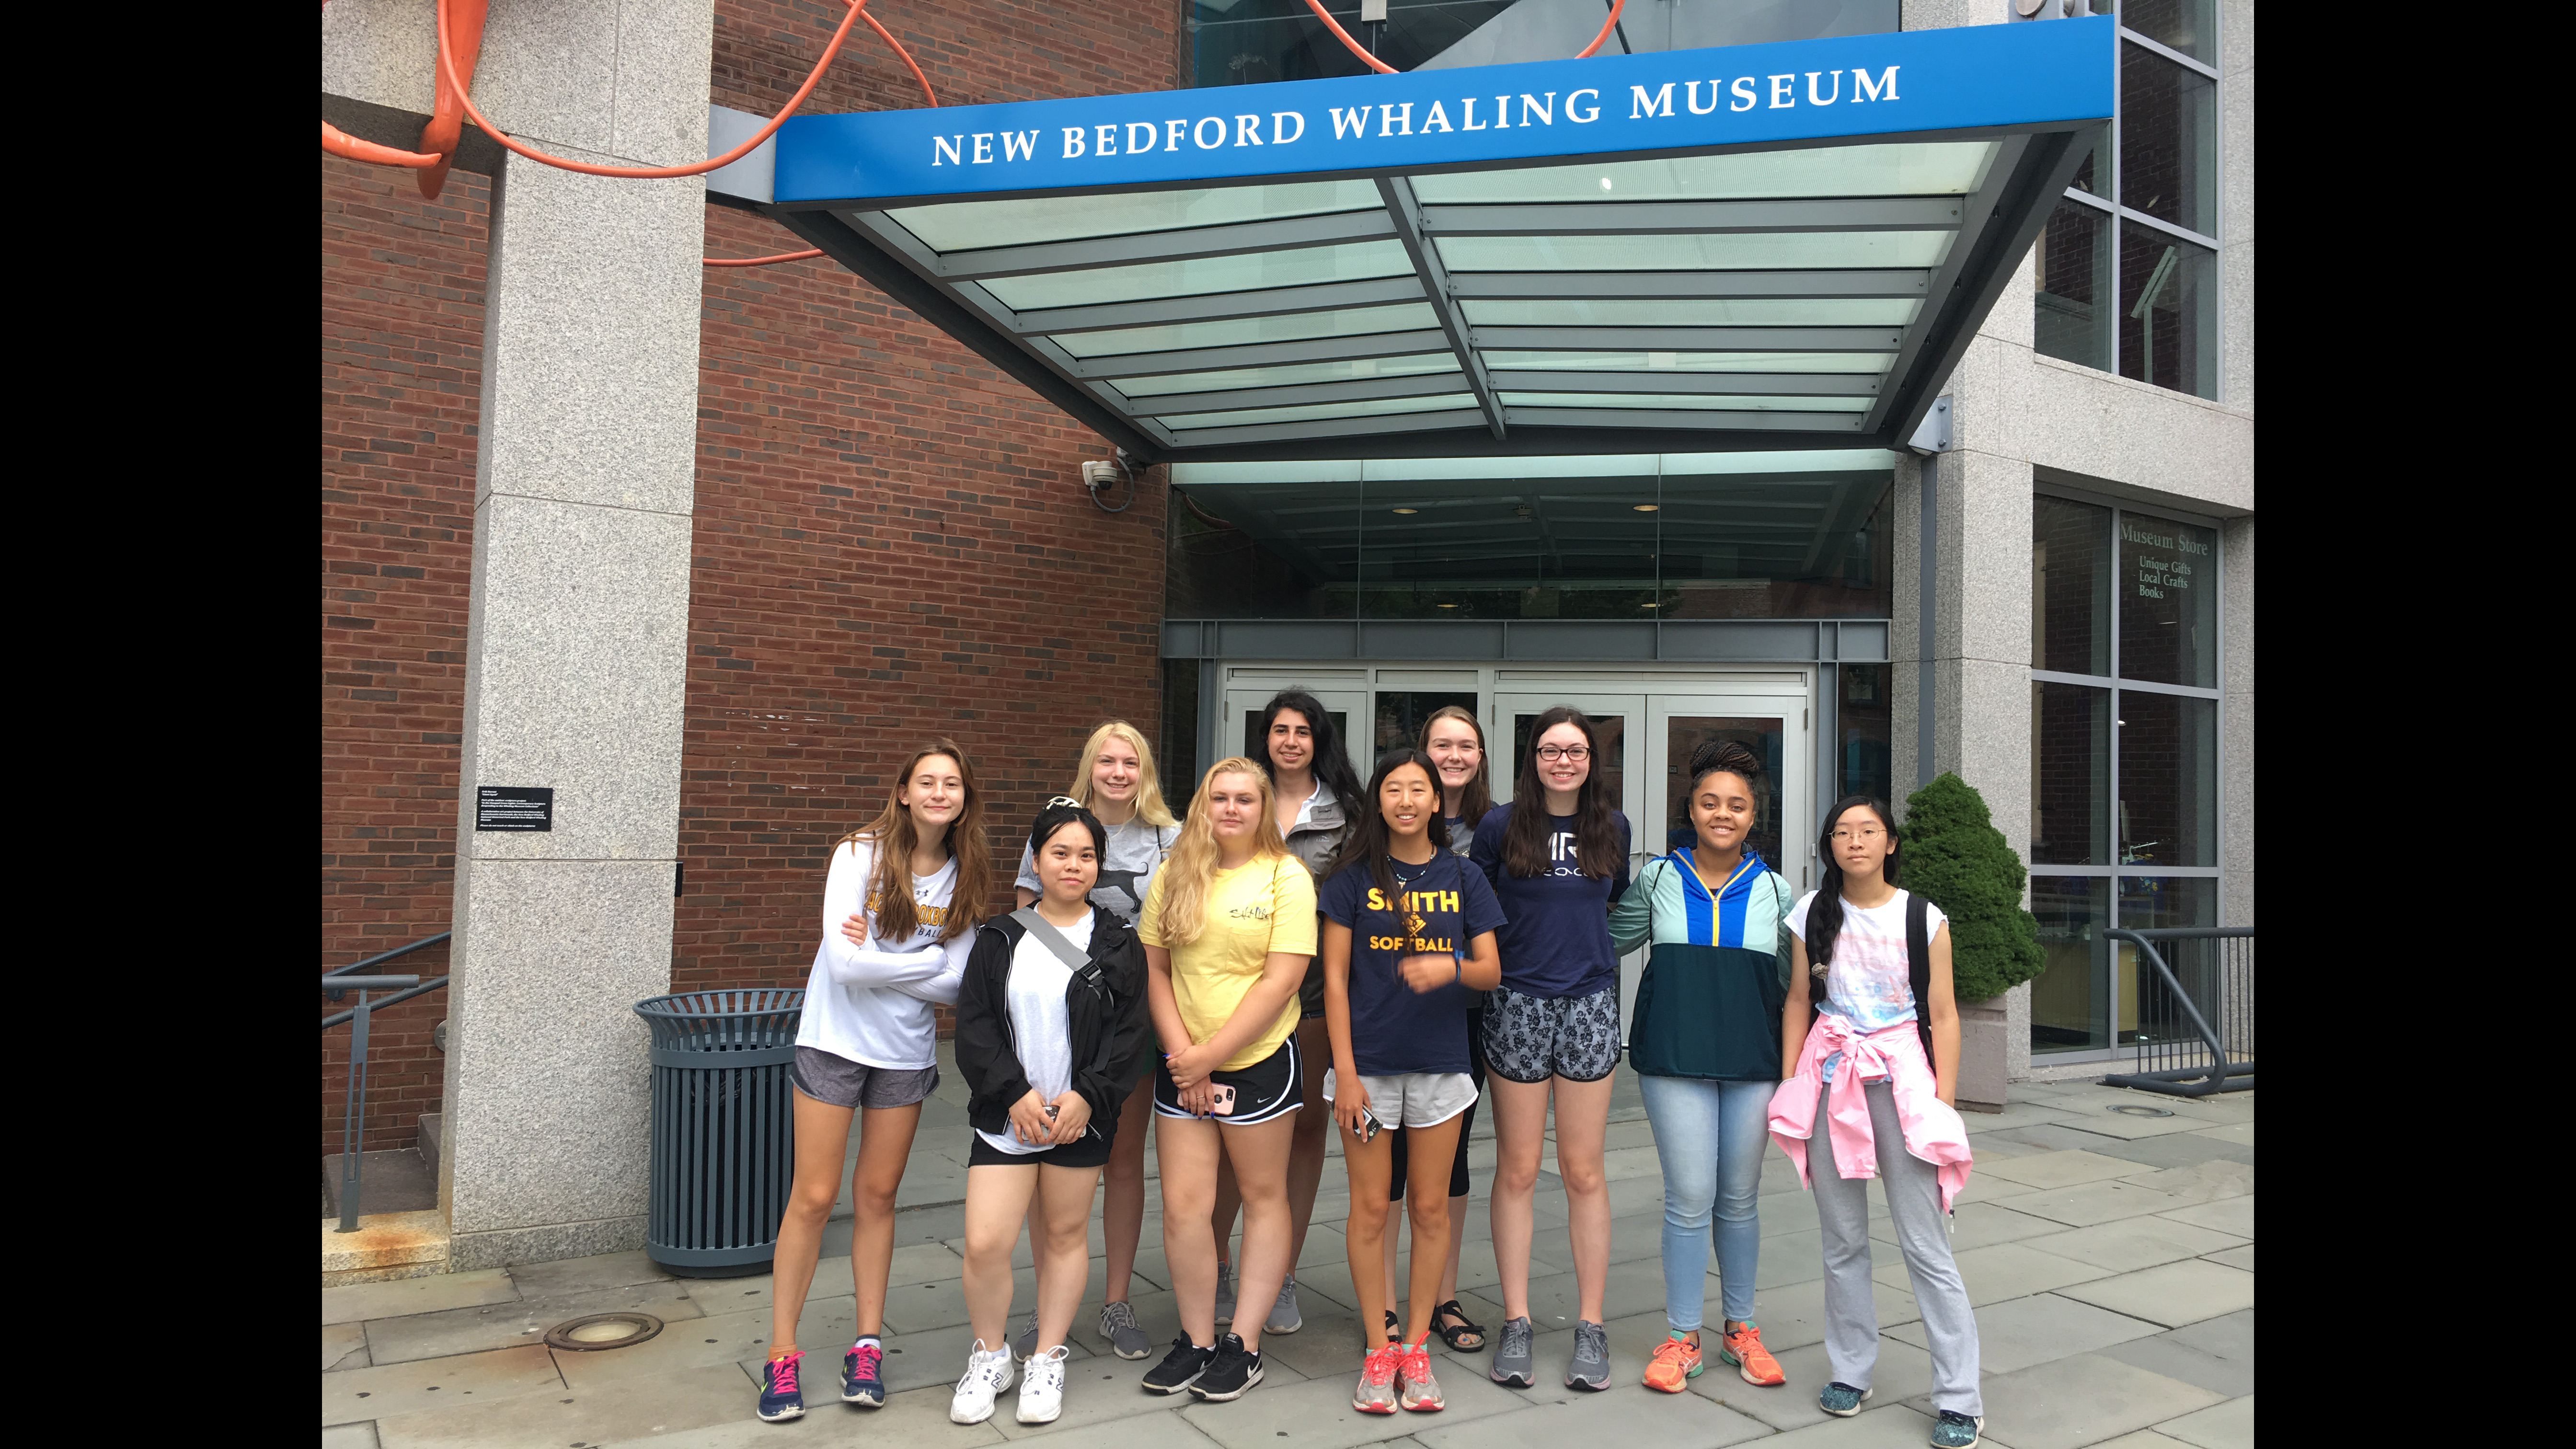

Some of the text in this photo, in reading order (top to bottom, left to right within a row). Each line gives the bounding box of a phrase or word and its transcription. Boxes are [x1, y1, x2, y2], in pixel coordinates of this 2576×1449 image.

[932, 66, 1900, 166] NEW BEDFORD WHALING MUSEUM
[2120, 523, 2208, 555] Museum Store
[2139, 555, 2191, 575] Unique Gifts
[2139, 570, 2188, 588] Local Crafts
[2139, 585, 2163, 599] Books
[1367, 888, 1459, 913] SMITH
